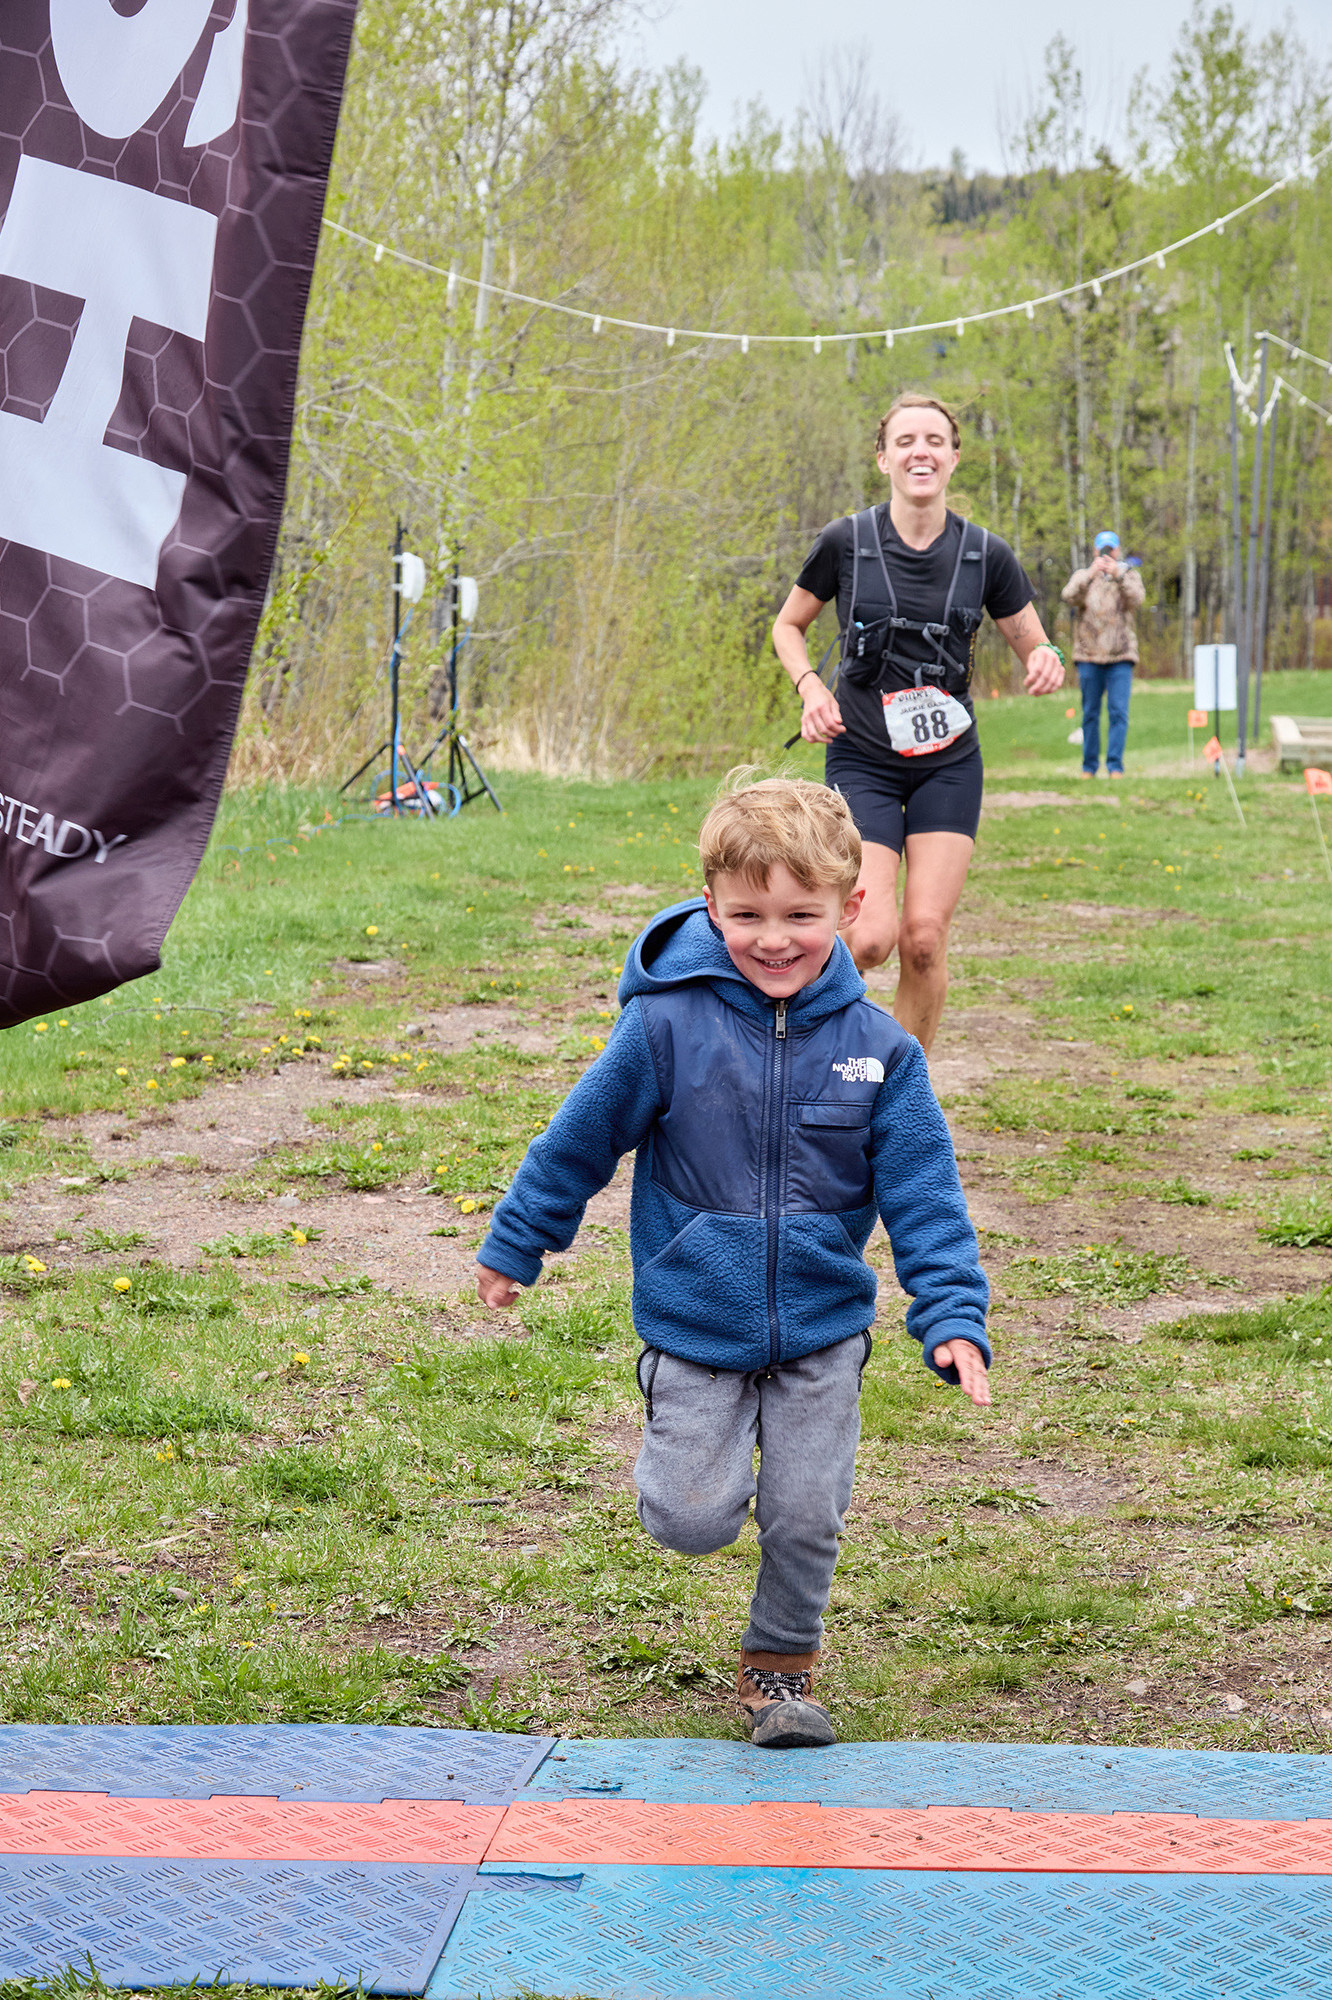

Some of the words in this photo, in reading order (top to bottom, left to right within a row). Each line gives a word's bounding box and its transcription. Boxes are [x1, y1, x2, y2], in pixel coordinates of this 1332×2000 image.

[911, 709, 949, 743] 88
[0, 792, 128, 864] TEADY
[832, 1063, 867, 1075] NORTH
[848, 1057, 867, 1067] THE
